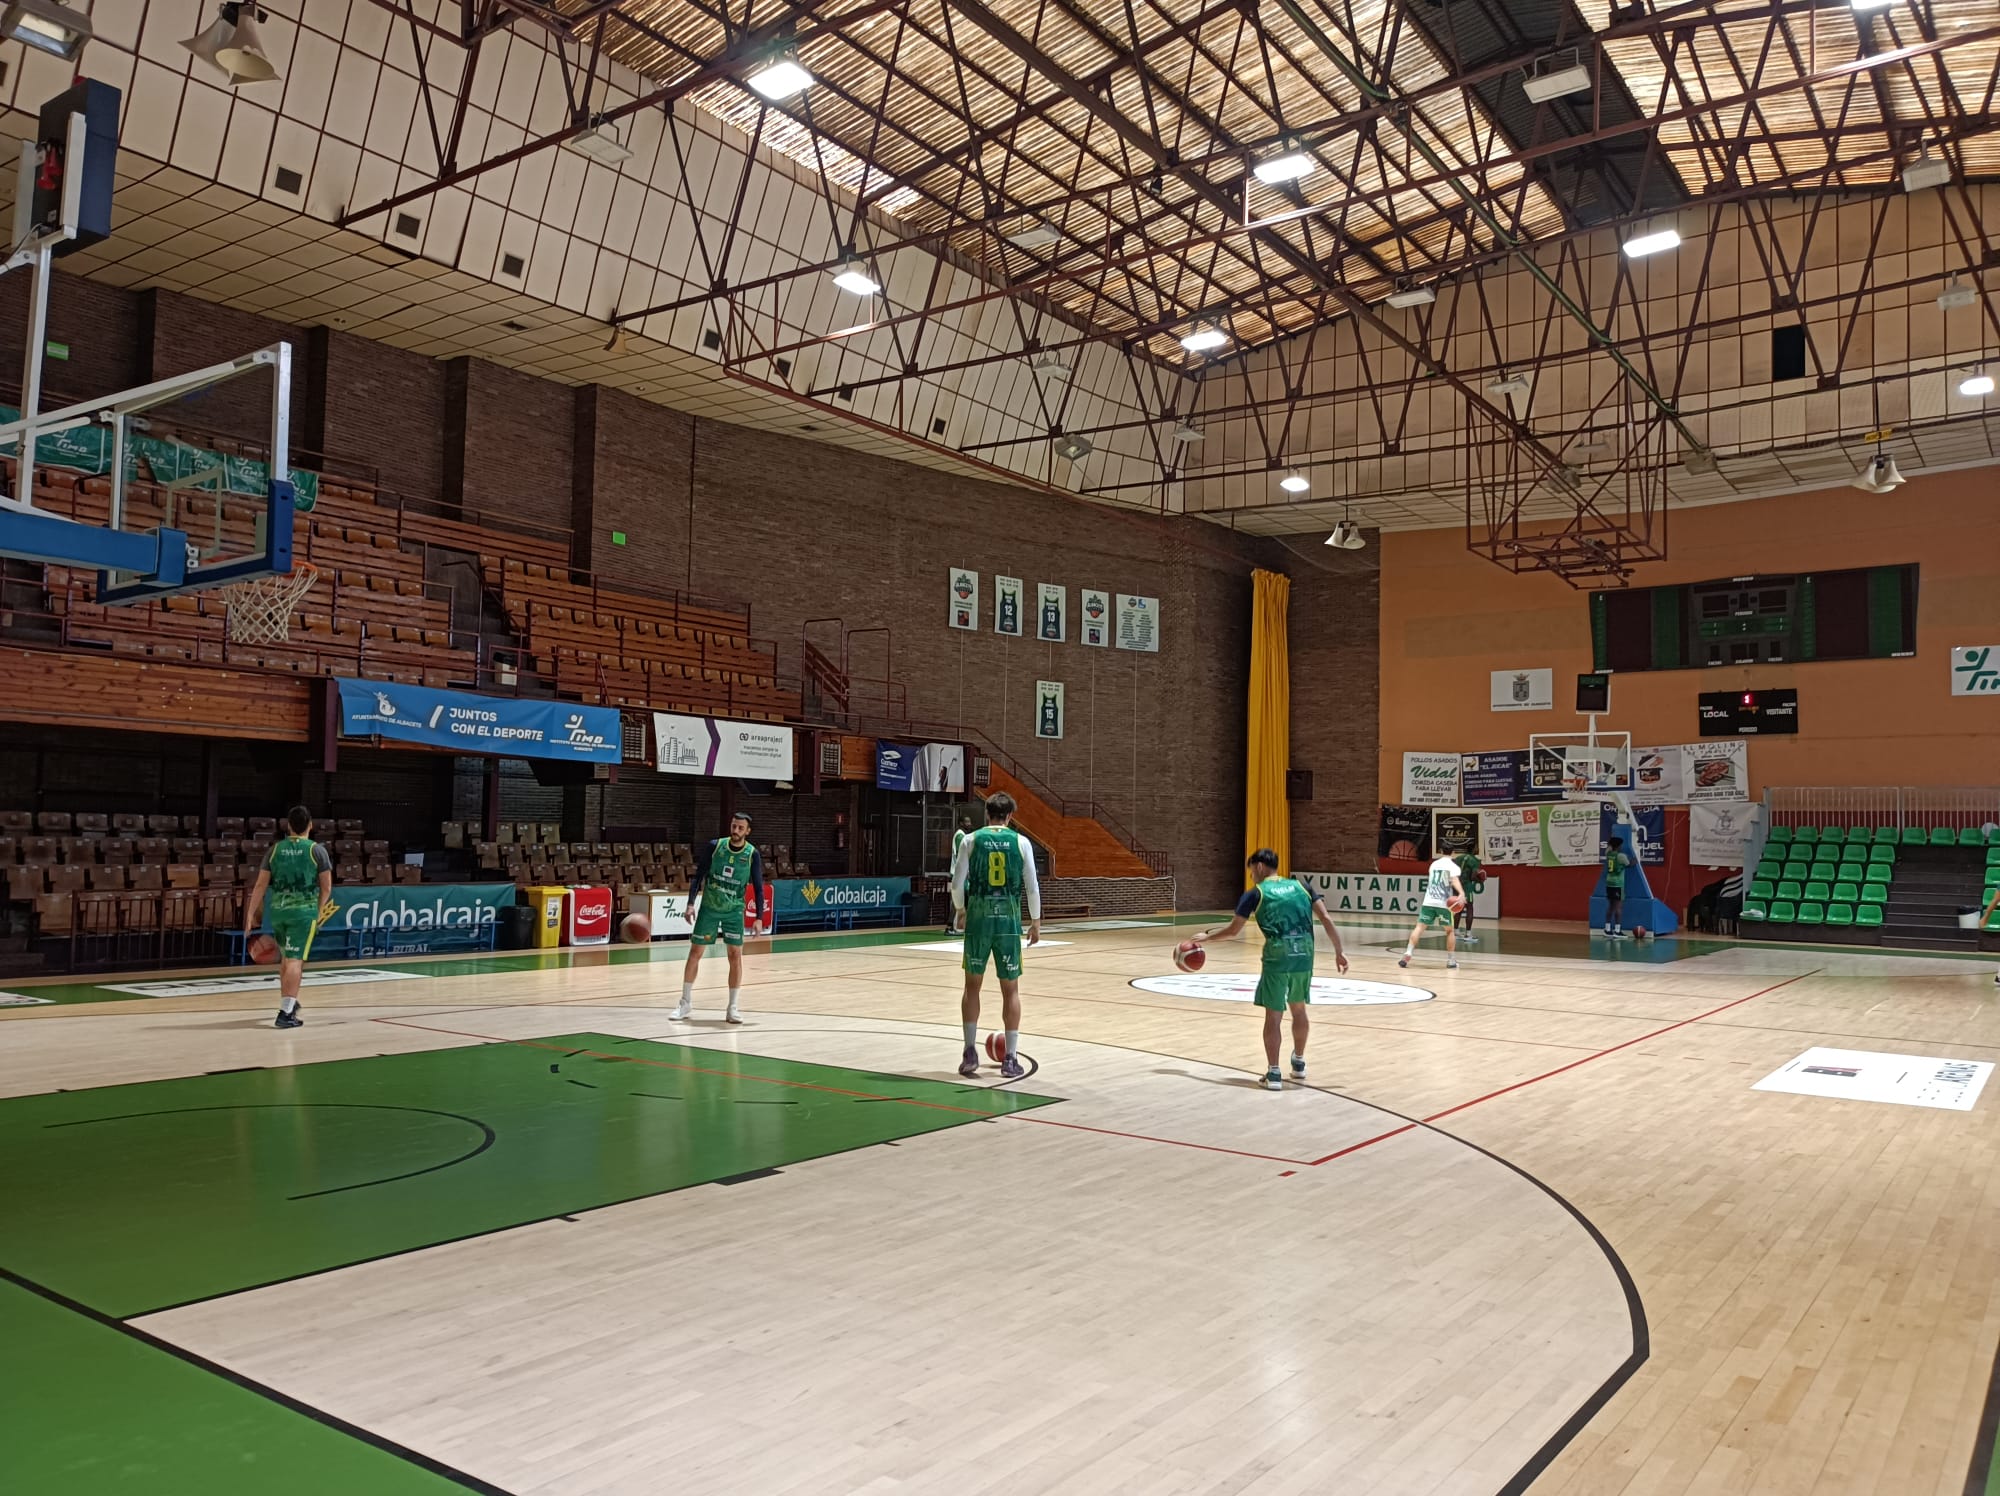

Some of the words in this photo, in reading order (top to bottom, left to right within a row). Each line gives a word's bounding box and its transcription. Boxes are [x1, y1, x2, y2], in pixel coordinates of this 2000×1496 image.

[1005, 605, 1013, 616] 12
[1047, 611, 1055, 622] 13
[449, 707, 498, 722] JUNTOS
[1045, 709, 1054, 719] 15
[451, 723, 475, 735] CON
[477, 725, 491, 737] EL
[493, 728, 544, 741] DEPORTE
[1410, 765, 1458, 778] Vidal
[988, 851, 1006, 887] 8
[1290, 874, 1486, 895] YUNTAMIEO
[823, 885, 888, 907] Globalcaja
[345, 898, 497, 938] Globalcaja
